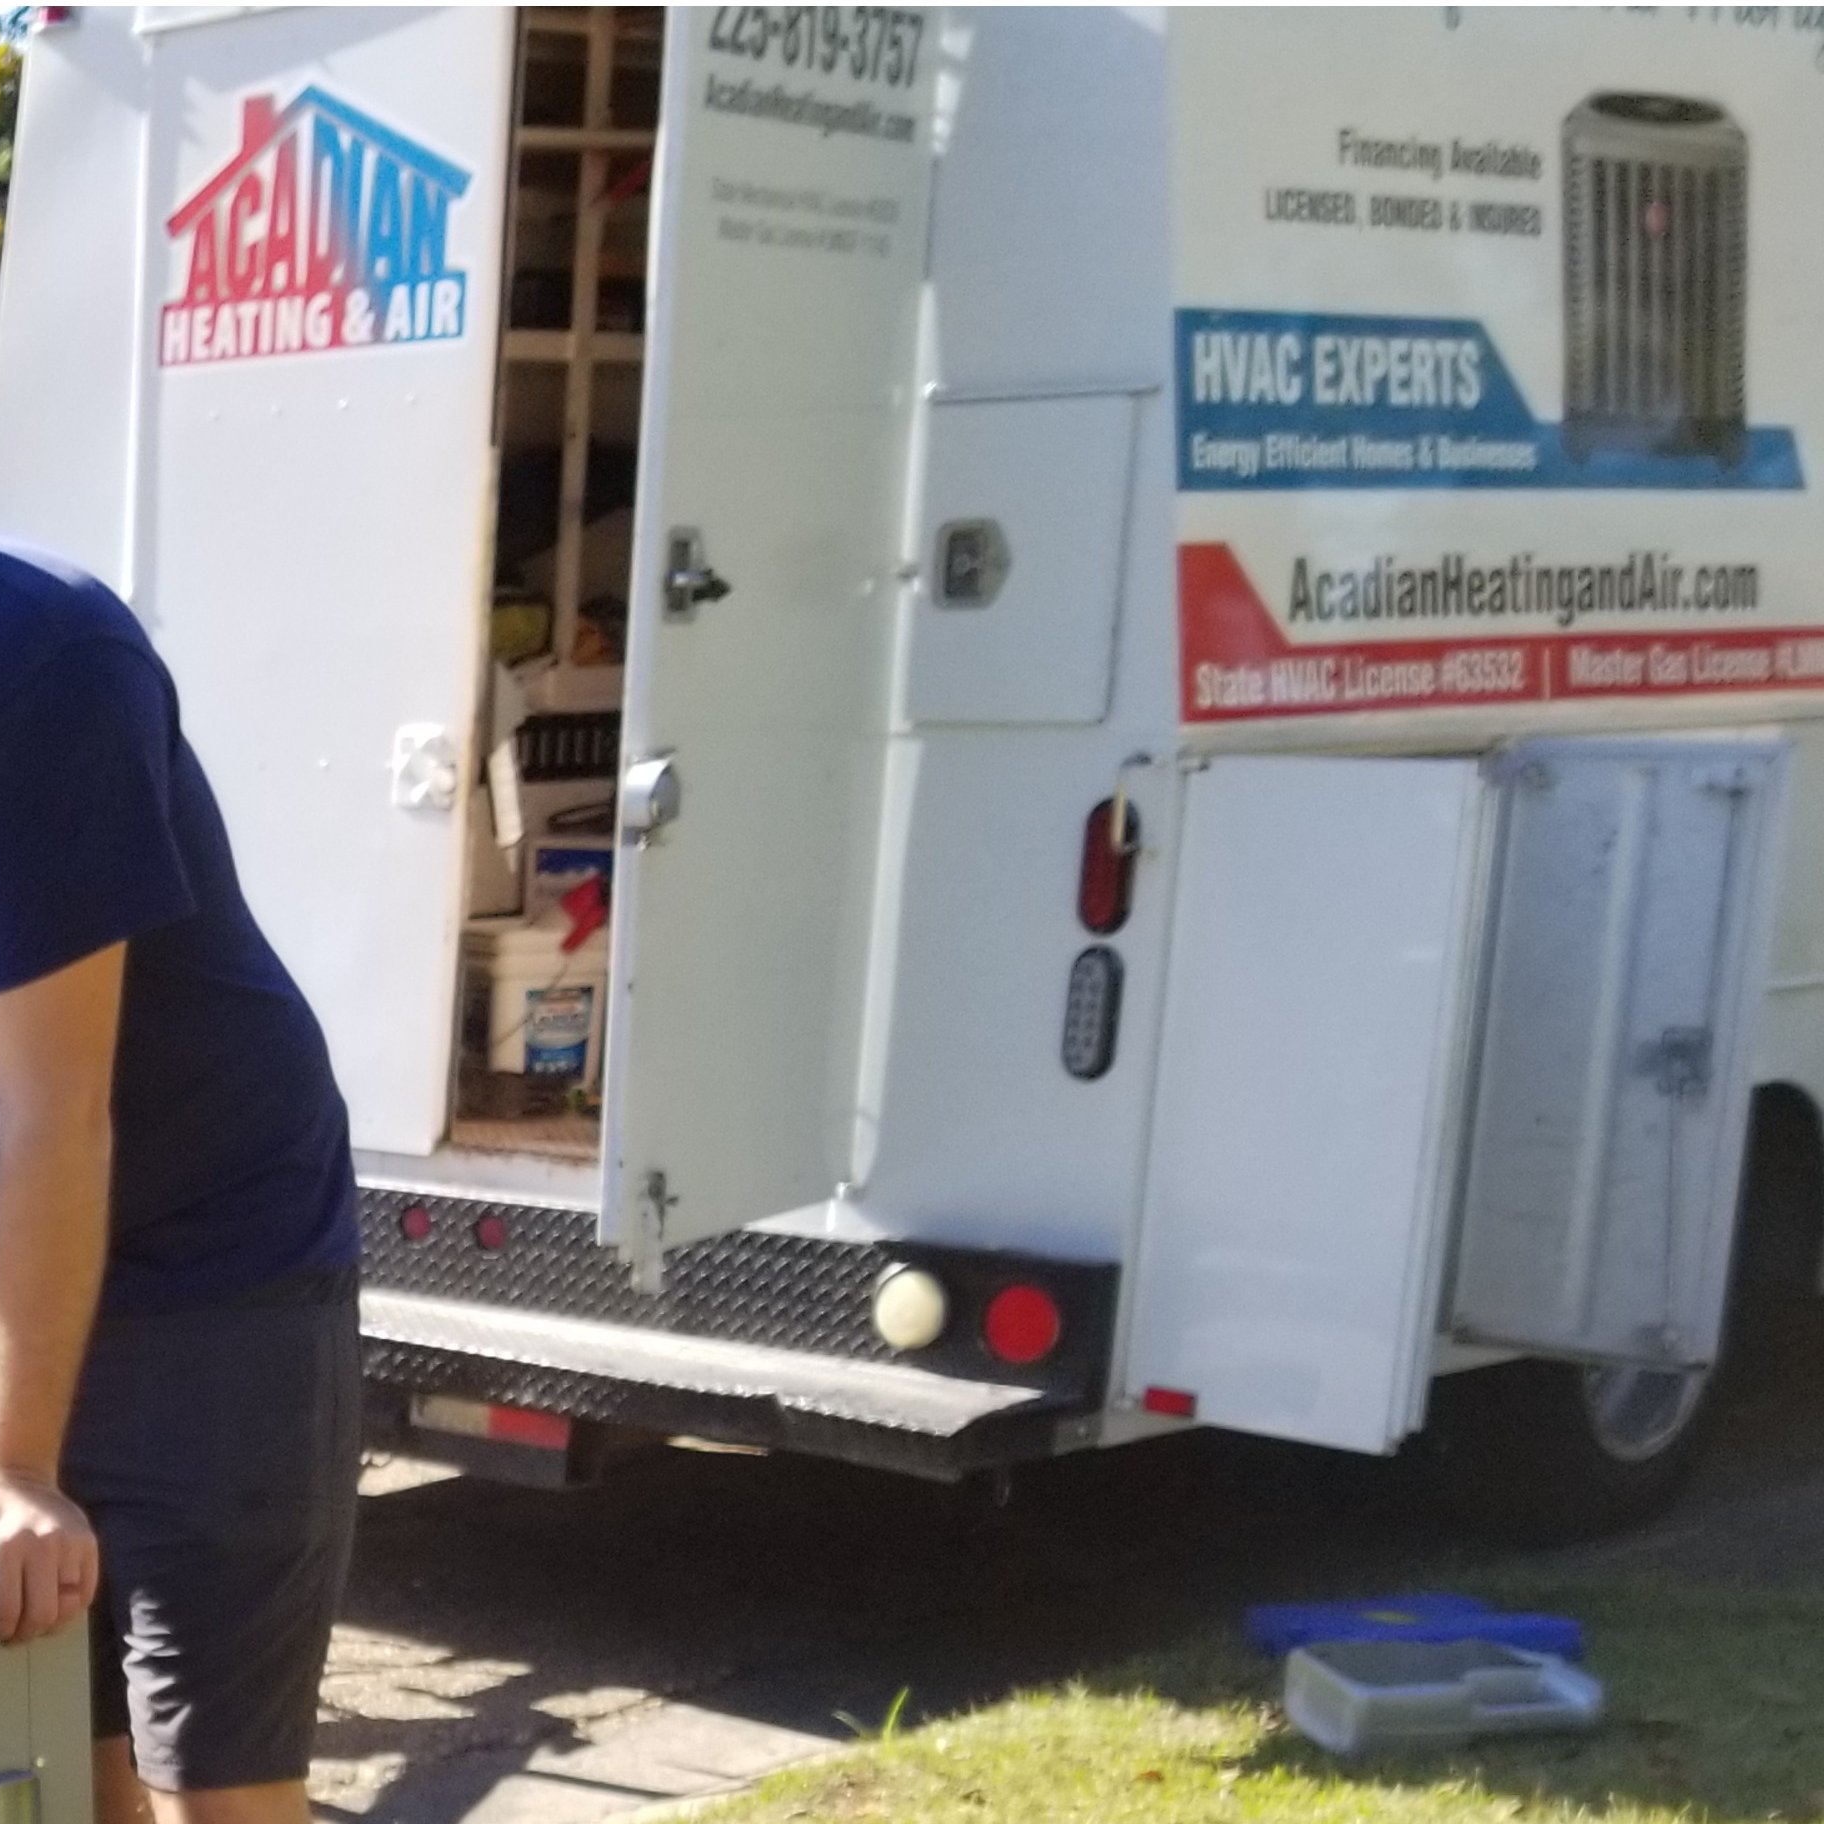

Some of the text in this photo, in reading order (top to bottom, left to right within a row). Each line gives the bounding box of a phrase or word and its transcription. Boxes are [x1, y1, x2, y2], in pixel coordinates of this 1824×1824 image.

[1338, 127, 1542, 181] Financing Available
[185, 110, 449, 302] ACADIAN
[163, 278, 461, 363] HEATING & AIR
[1193, 332, 1481, 409] HVAC EXPERTS
[1192, 434, 1260, 477] Energy
[1266, 433, 1347, 469] Efficient
[1288, 553, 1761, 627] AcadianHeatingandAir.com
[1196, 664, 1264, 709] State
[1272, 657, 1336, 701] HVAC
[1344, 655, 1435, 699] License
